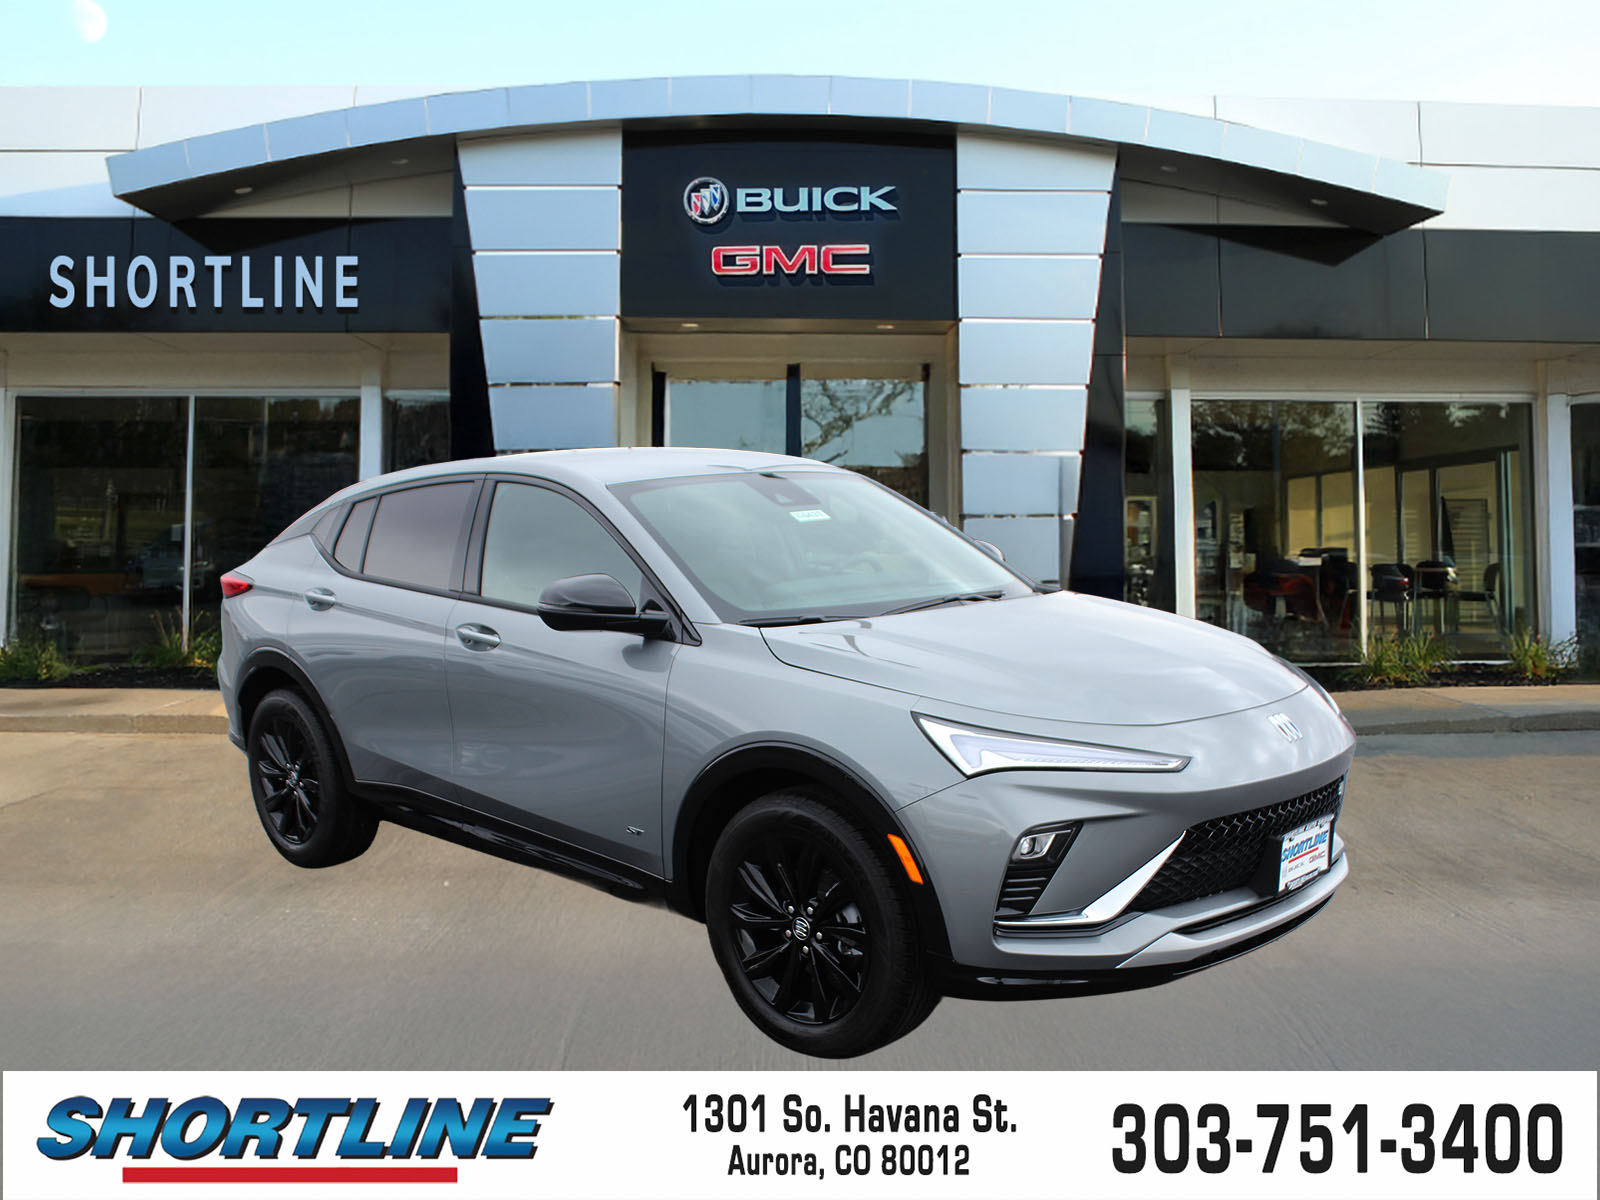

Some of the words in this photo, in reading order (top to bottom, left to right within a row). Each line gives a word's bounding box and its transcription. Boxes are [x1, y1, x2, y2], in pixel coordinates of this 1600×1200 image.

[735, 186, 898, 213] BUICK
[711, 244, 870, 275] GMC
[49, 255, 359, 309] SHORTLINE
[1281, 830, 1329, 862] SHORTLINE
